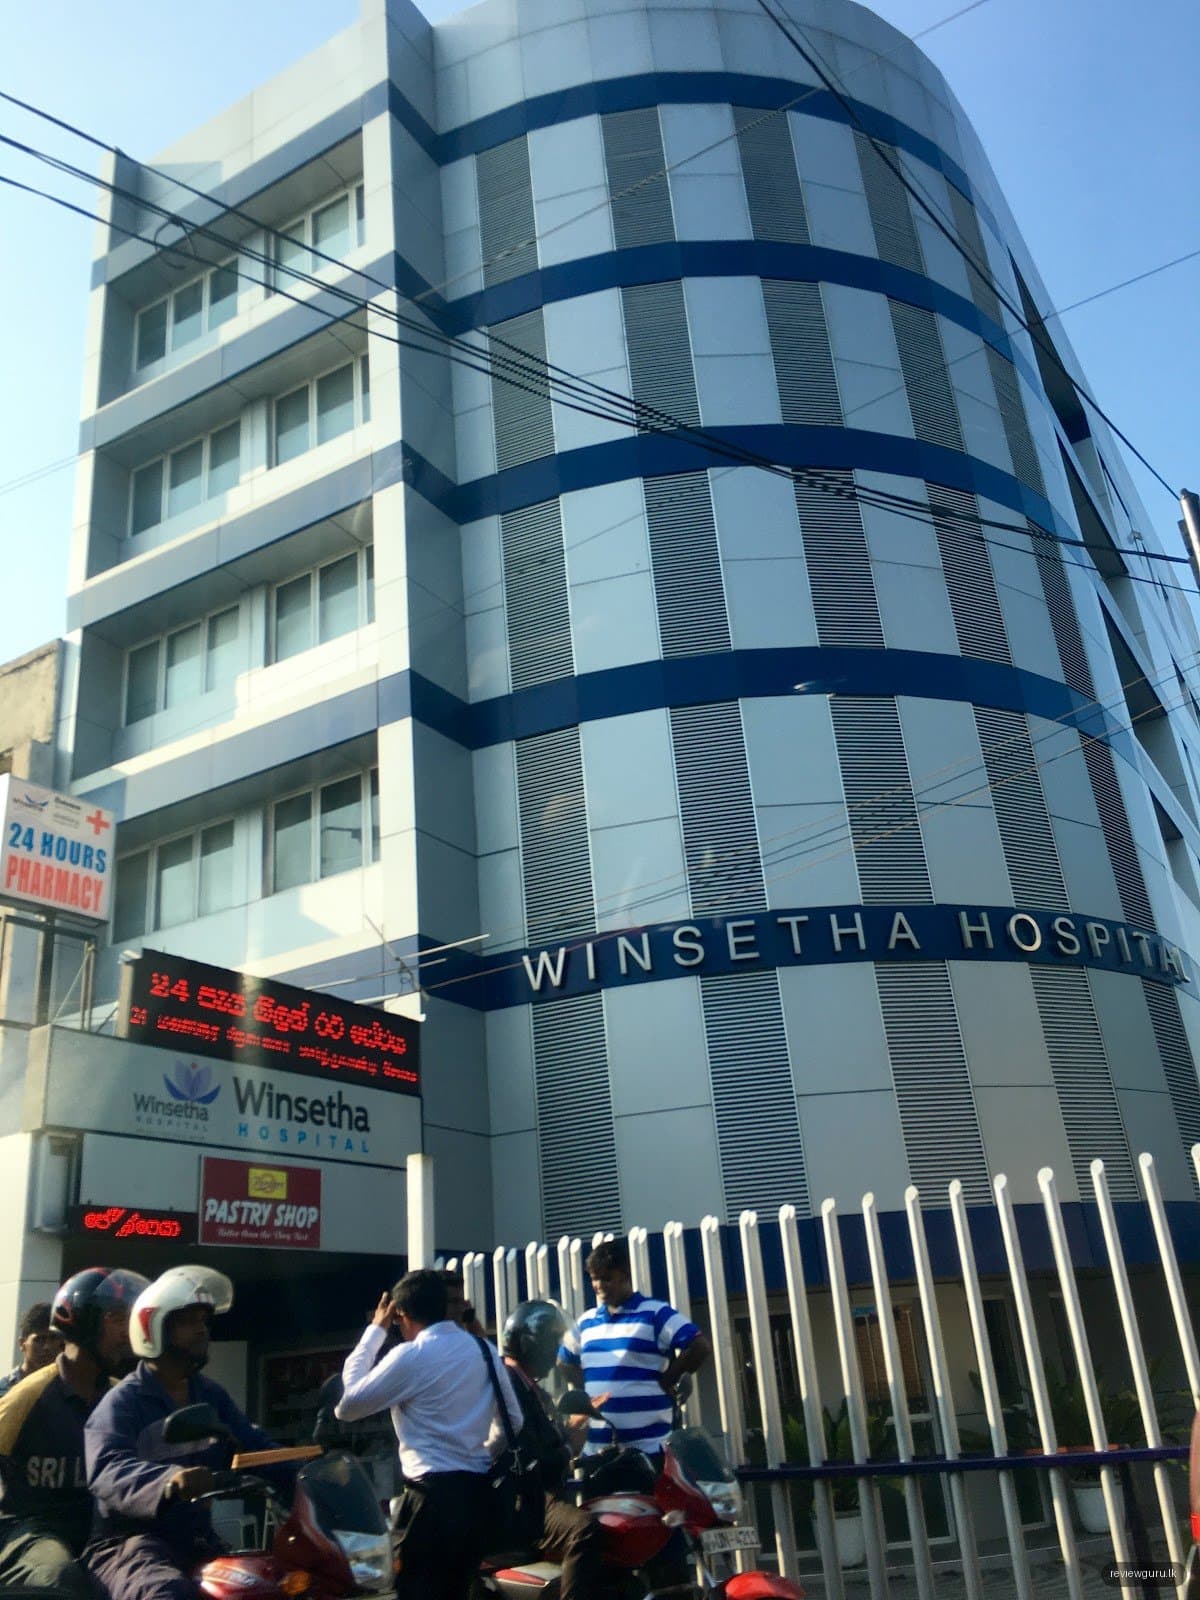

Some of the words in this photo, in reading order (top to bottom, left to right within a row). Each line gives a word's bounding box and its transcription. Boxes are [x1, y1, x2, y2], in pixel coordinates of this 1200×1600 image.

[9, 822, 35, 852] 24
[40, 832, 106, 873] HOURS
[5, 855, 104, 911] PHARMACY
[521, 911, 922, 992] WINSETHA
[150, 971, 190, 1002] 24
[133, 1092, 209, 1121] Winsetha
[233, 1076, 370, 1132] Winsetha
[237, 1123, 369, 1153] HOSPITAL
[204, 1198, 272, 1229] PASTRY
[274, 1203, 319, 1230] SHOP
[26, 1456, 66, 1488] SRI
